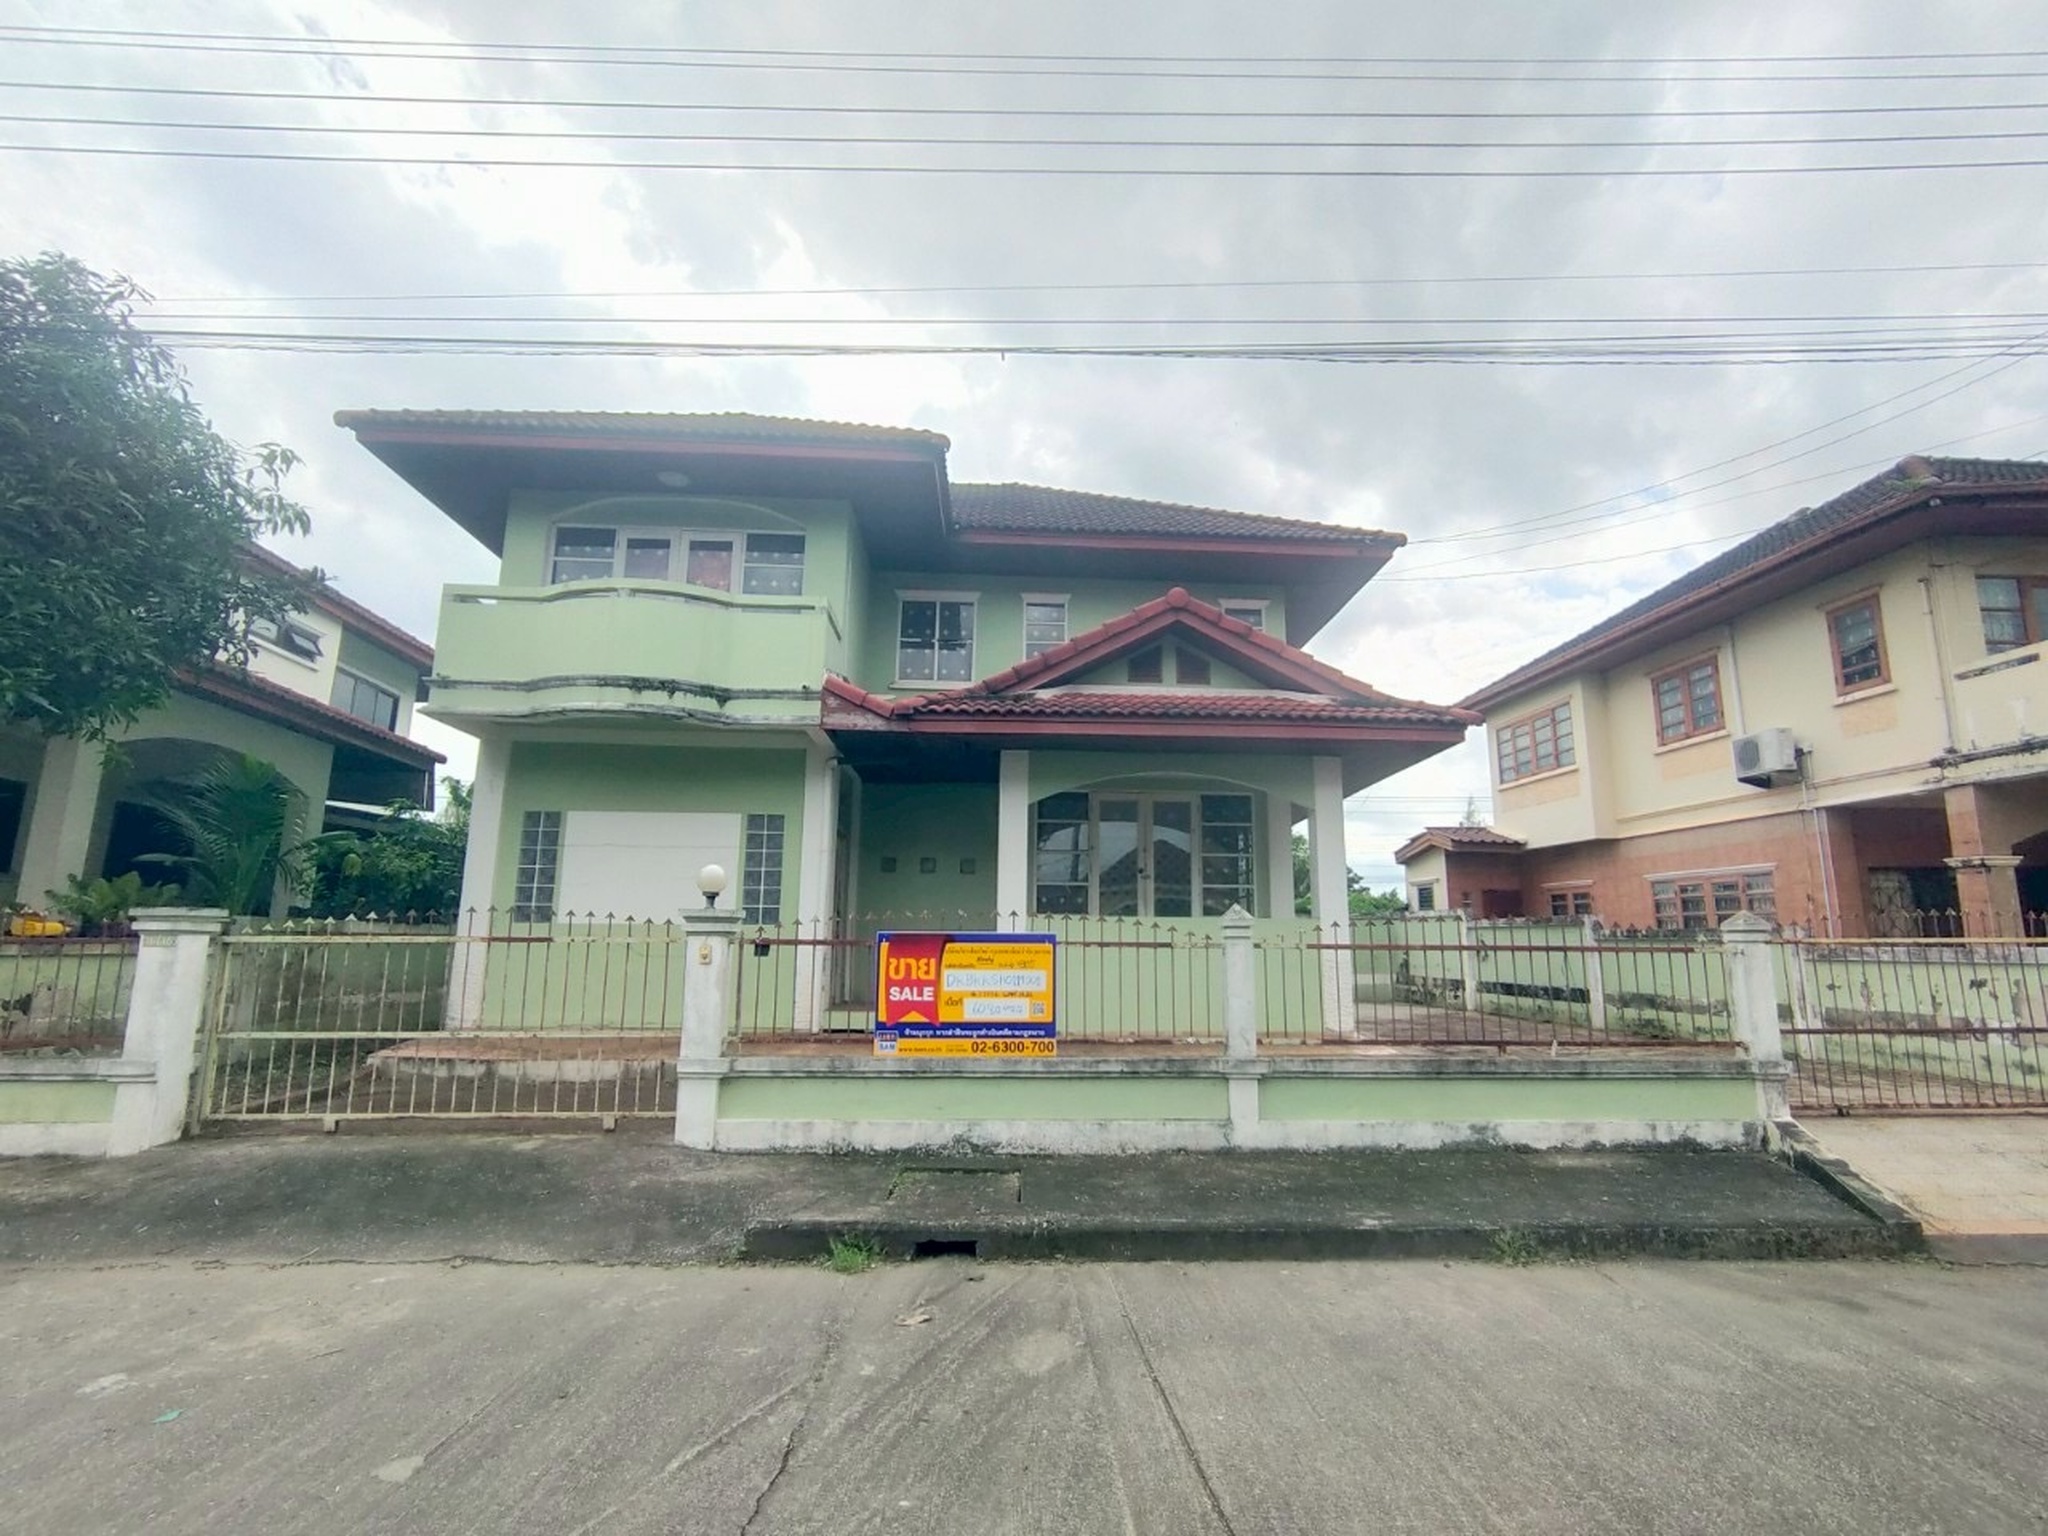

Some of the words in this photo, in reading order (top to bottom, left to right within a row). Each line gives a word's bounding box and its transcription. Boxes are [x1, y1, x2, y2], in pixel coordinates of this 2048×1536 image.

[888, 957, 936, 980] ขาย
[889, 986, 934, 1001] SALE
[971, 1040, 1055, 1053] 02-6300-700
